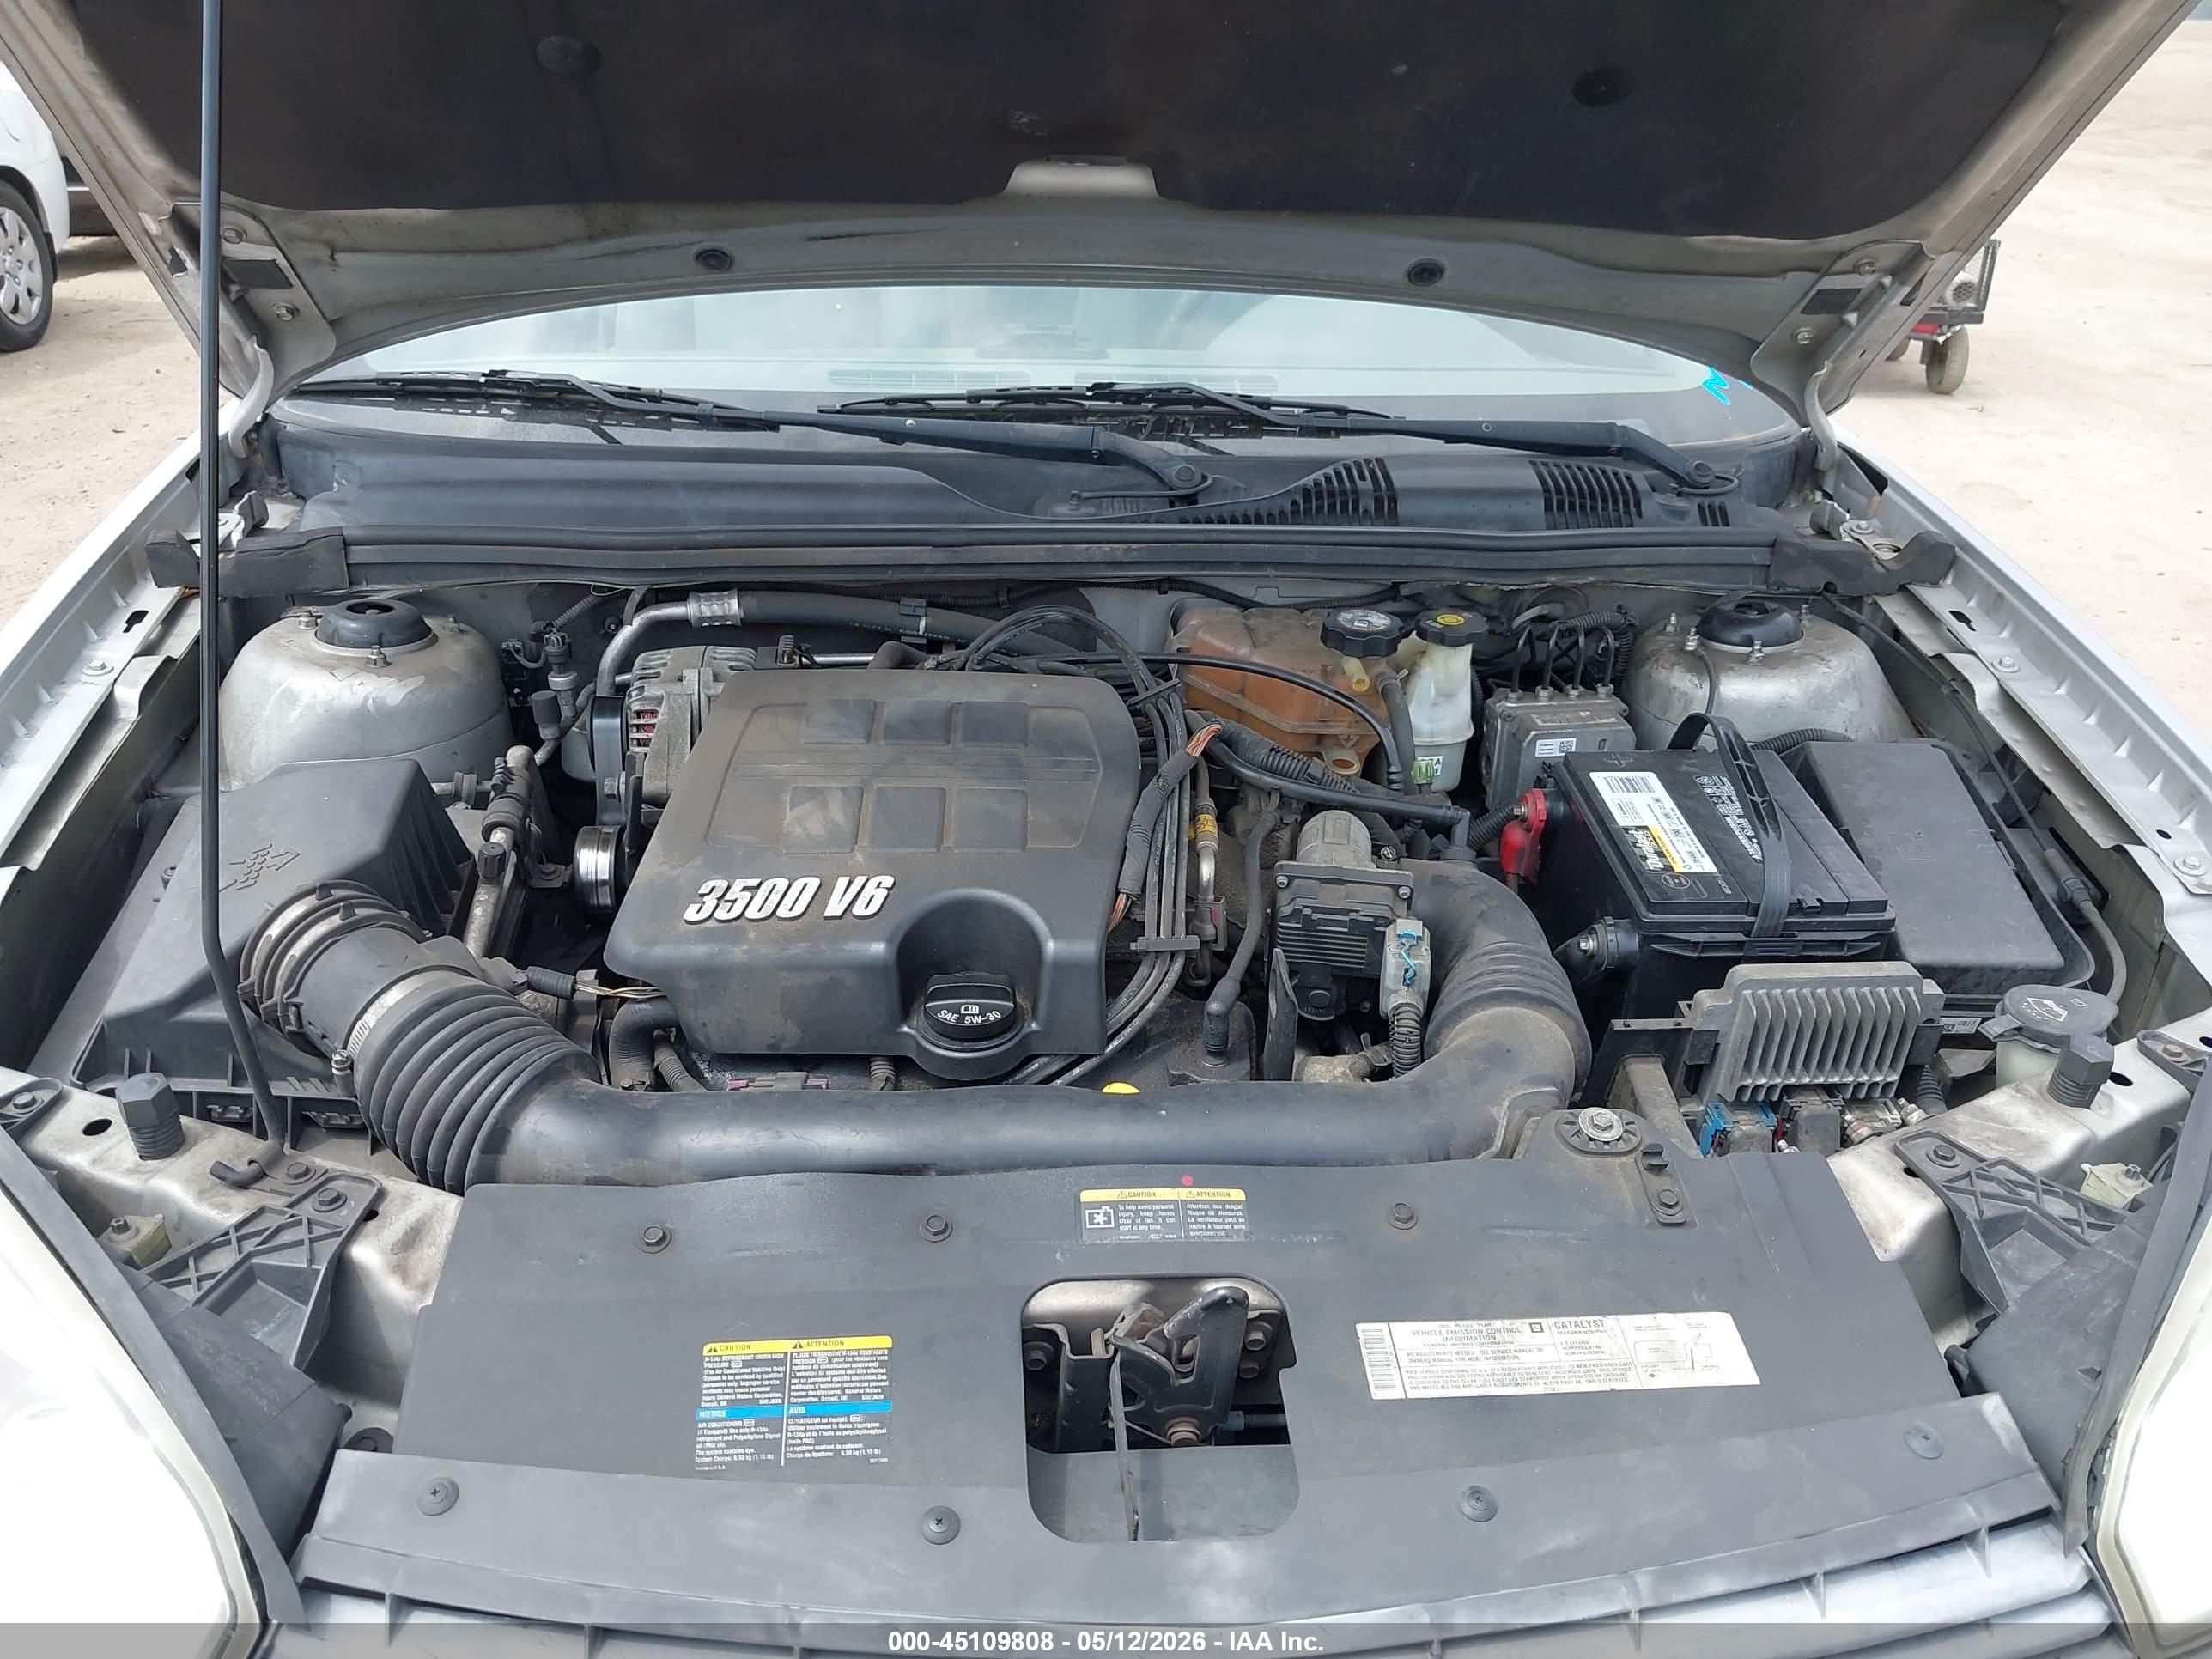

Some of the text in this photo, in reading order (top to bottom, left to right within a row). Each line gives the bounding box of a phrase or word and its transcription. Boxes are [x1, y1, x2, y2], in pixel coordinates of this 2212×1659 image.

[683, 874, 896, 922] 3500 V6
[937, 1010, 1001, 1024] SAE 5W-30
[1554, 1320, 1604, 1329] CATALYST
